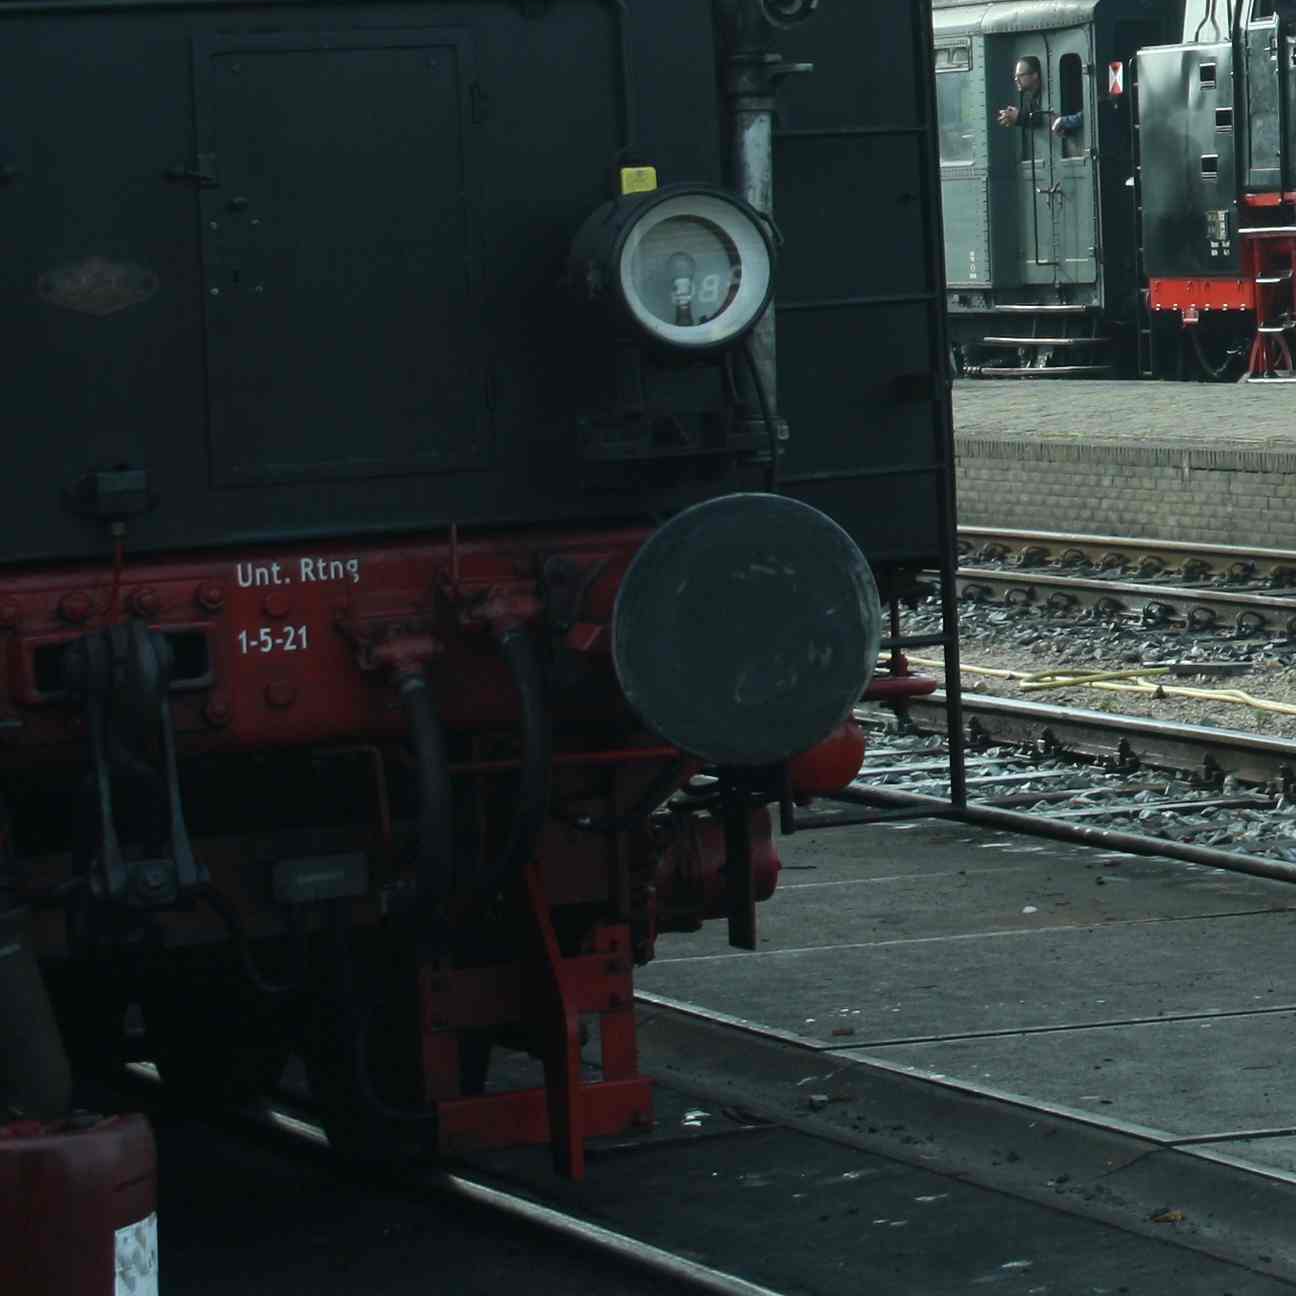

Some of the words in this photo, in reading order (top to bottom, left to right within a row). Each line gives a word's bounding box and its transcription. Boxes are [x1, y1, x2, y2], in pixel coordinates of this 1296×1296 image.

[236, 562, 291, 588] Unt.
[299, 556, 360, 583] Rtng
[238, 624, 308, 655] 1-5-21
